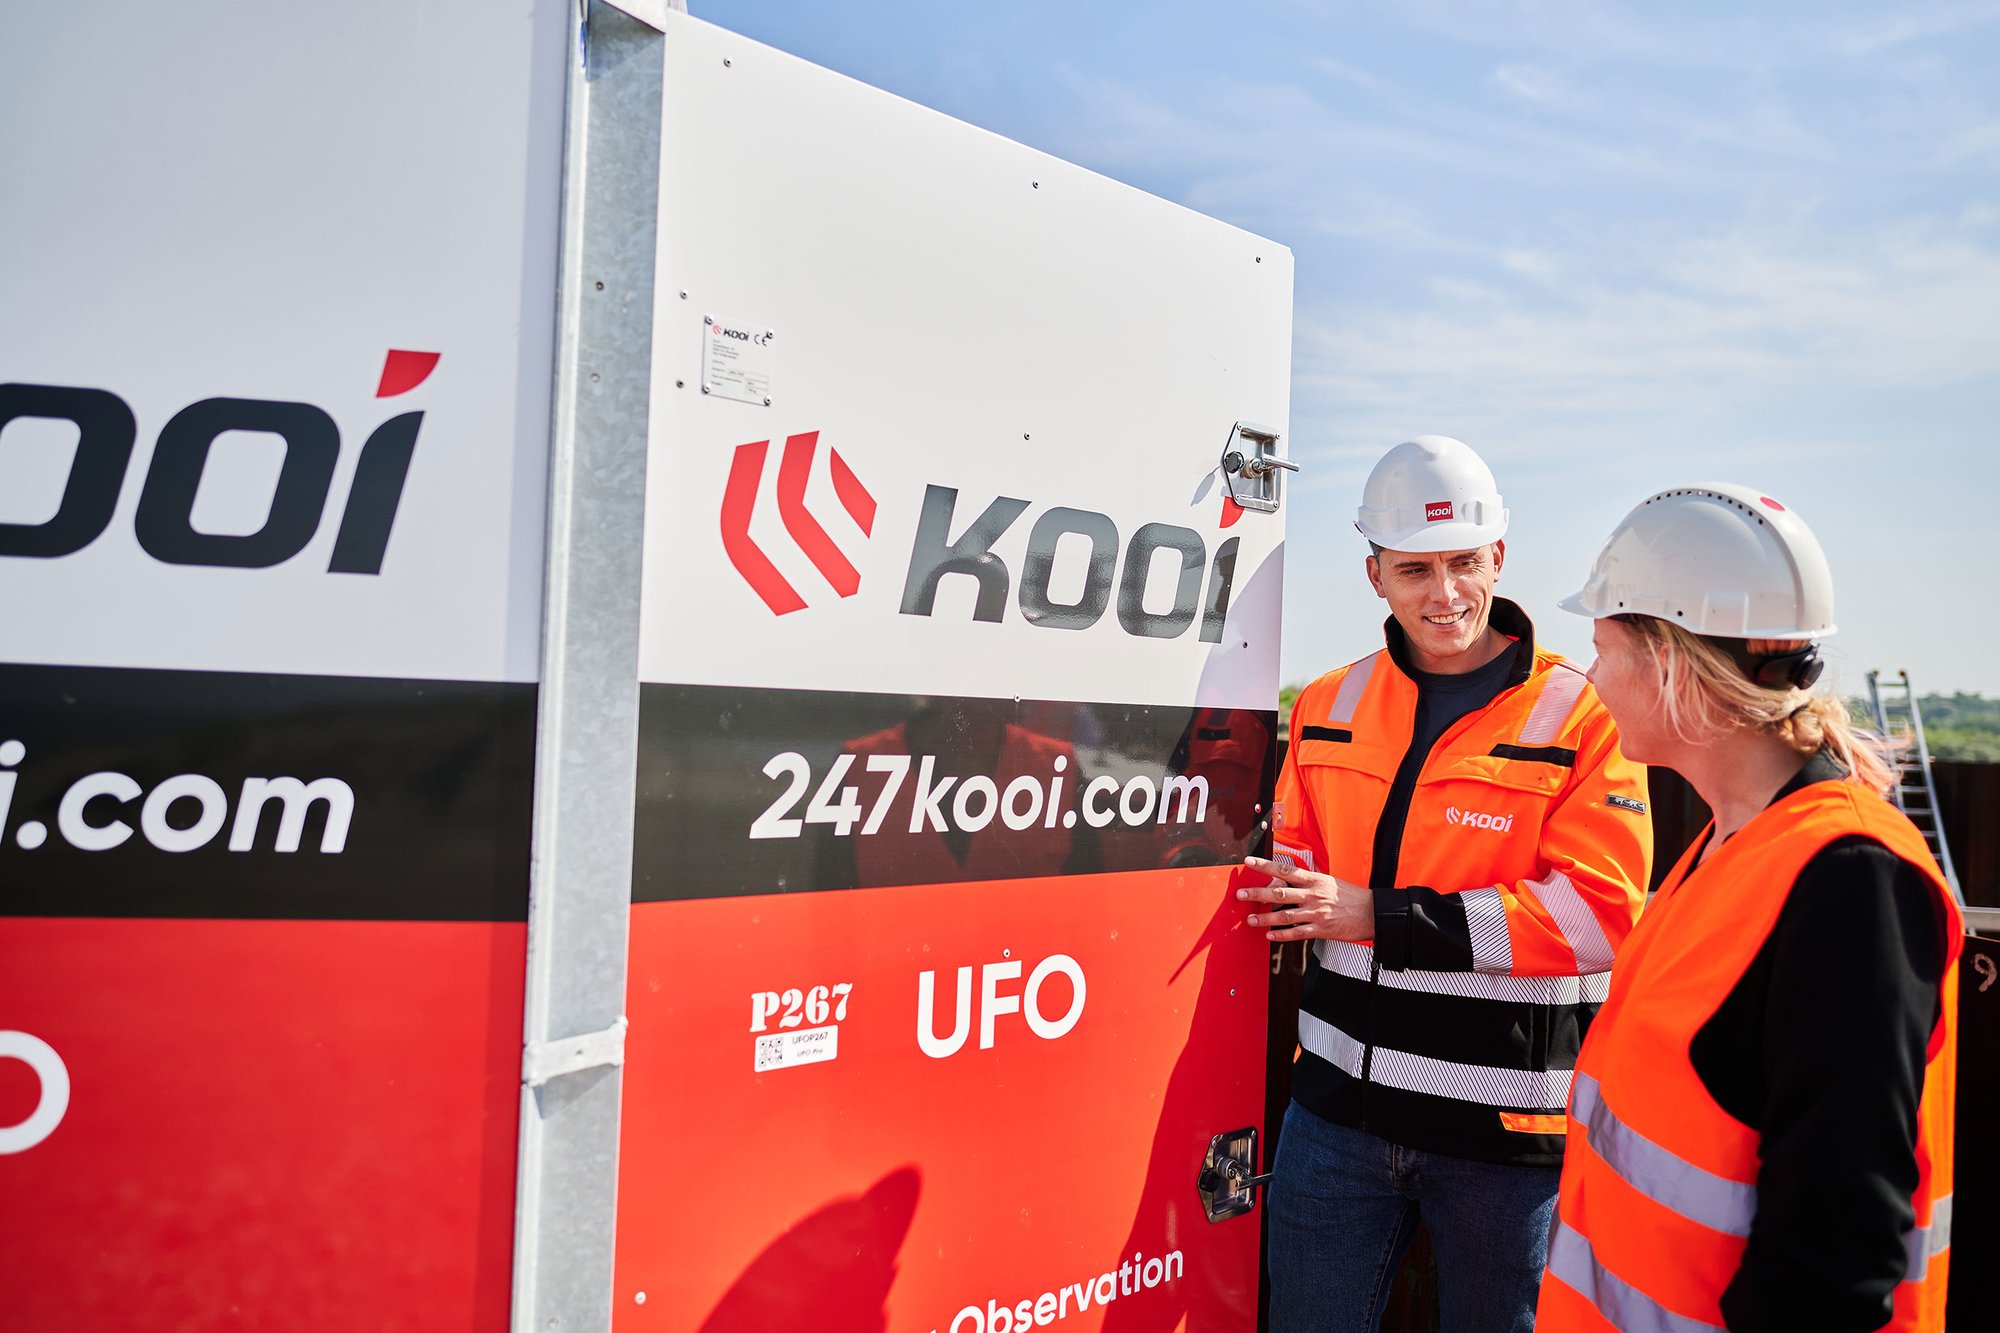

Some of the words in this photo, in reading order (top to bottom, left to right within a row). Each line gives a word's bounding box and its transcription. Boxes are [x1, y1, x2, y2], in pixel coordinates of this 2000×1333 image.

[749, 751, 1209, 839] 247kooi.com
[749, 983, 853, 1033] P267
[916, 954, 1087, 1059] UFO
[949, 1249, 1183, 1333] Observation
